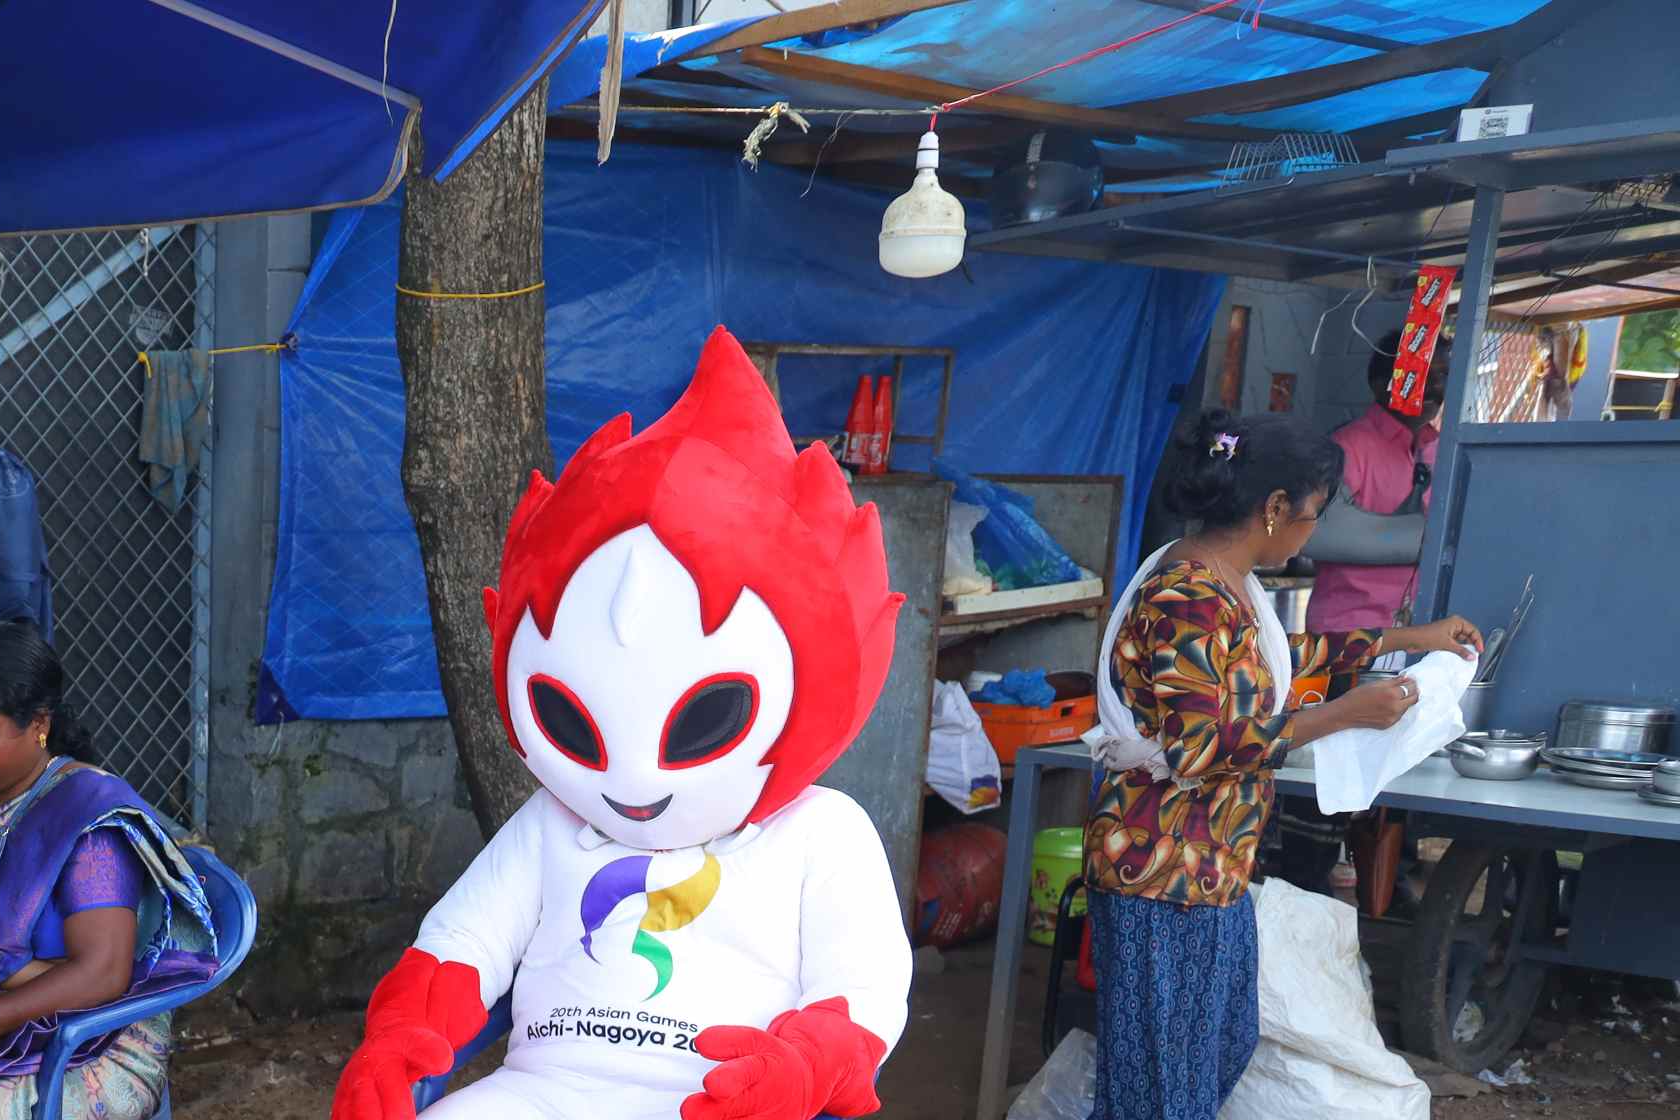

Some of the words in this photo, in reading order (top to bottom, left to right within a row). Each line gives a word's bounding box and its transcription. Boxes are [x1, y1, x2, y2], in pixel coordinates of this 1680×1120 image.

[527, 1019, 666, 1047] Aichi-Nagoya
[550, 1006, 582, 1018] 20th
[586, 1006, 631, 1020] Asian
[636, 1012, 699, 1033] Games
